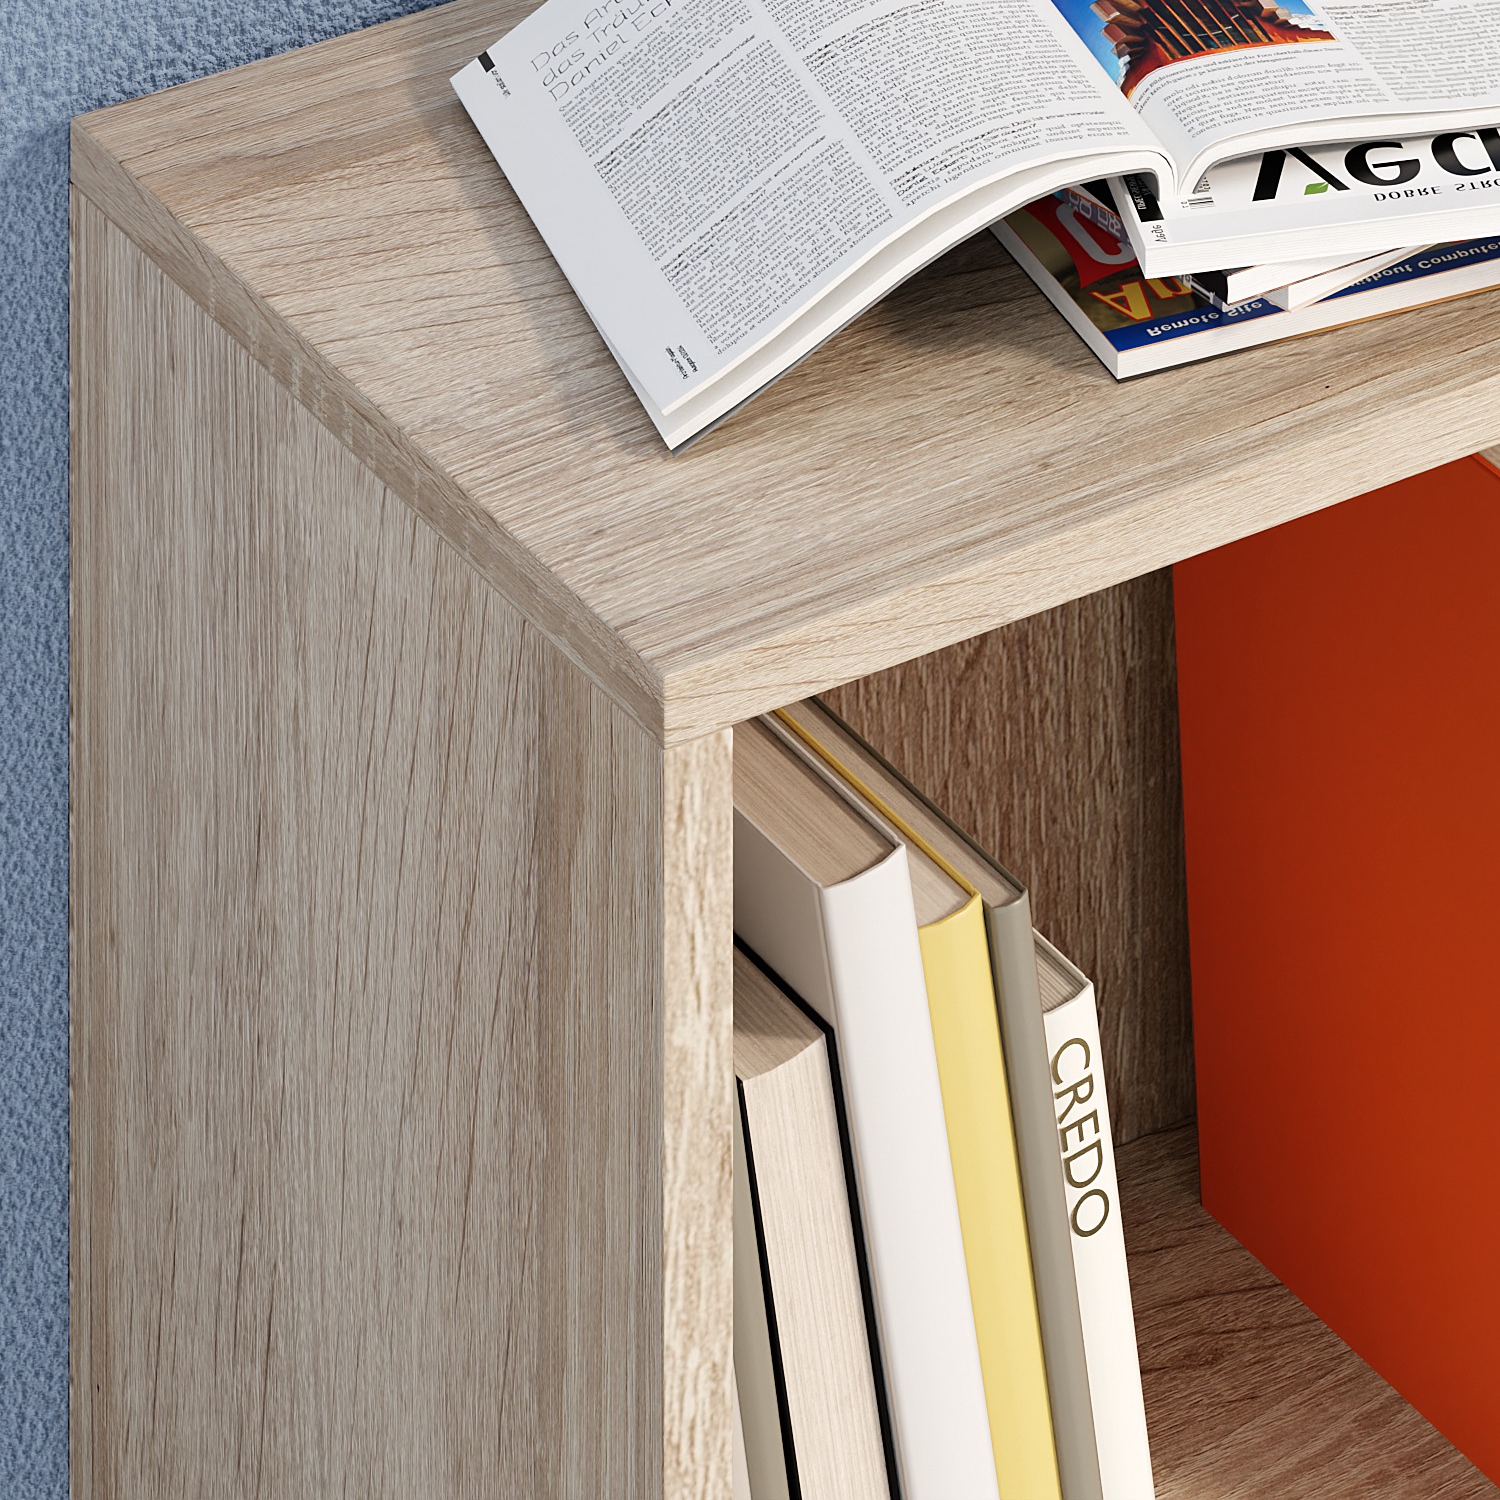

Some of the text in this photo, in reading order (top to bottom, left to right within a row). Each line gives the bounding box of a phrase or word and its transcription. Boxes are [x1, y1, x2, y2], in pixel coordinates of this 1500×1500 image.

[530, 31, 579, 72] Das
[542, 48, 585, 87] das
[548, 34, 629, 102] Daniel
[1051, 1038, 1110, 1238] CREDO
